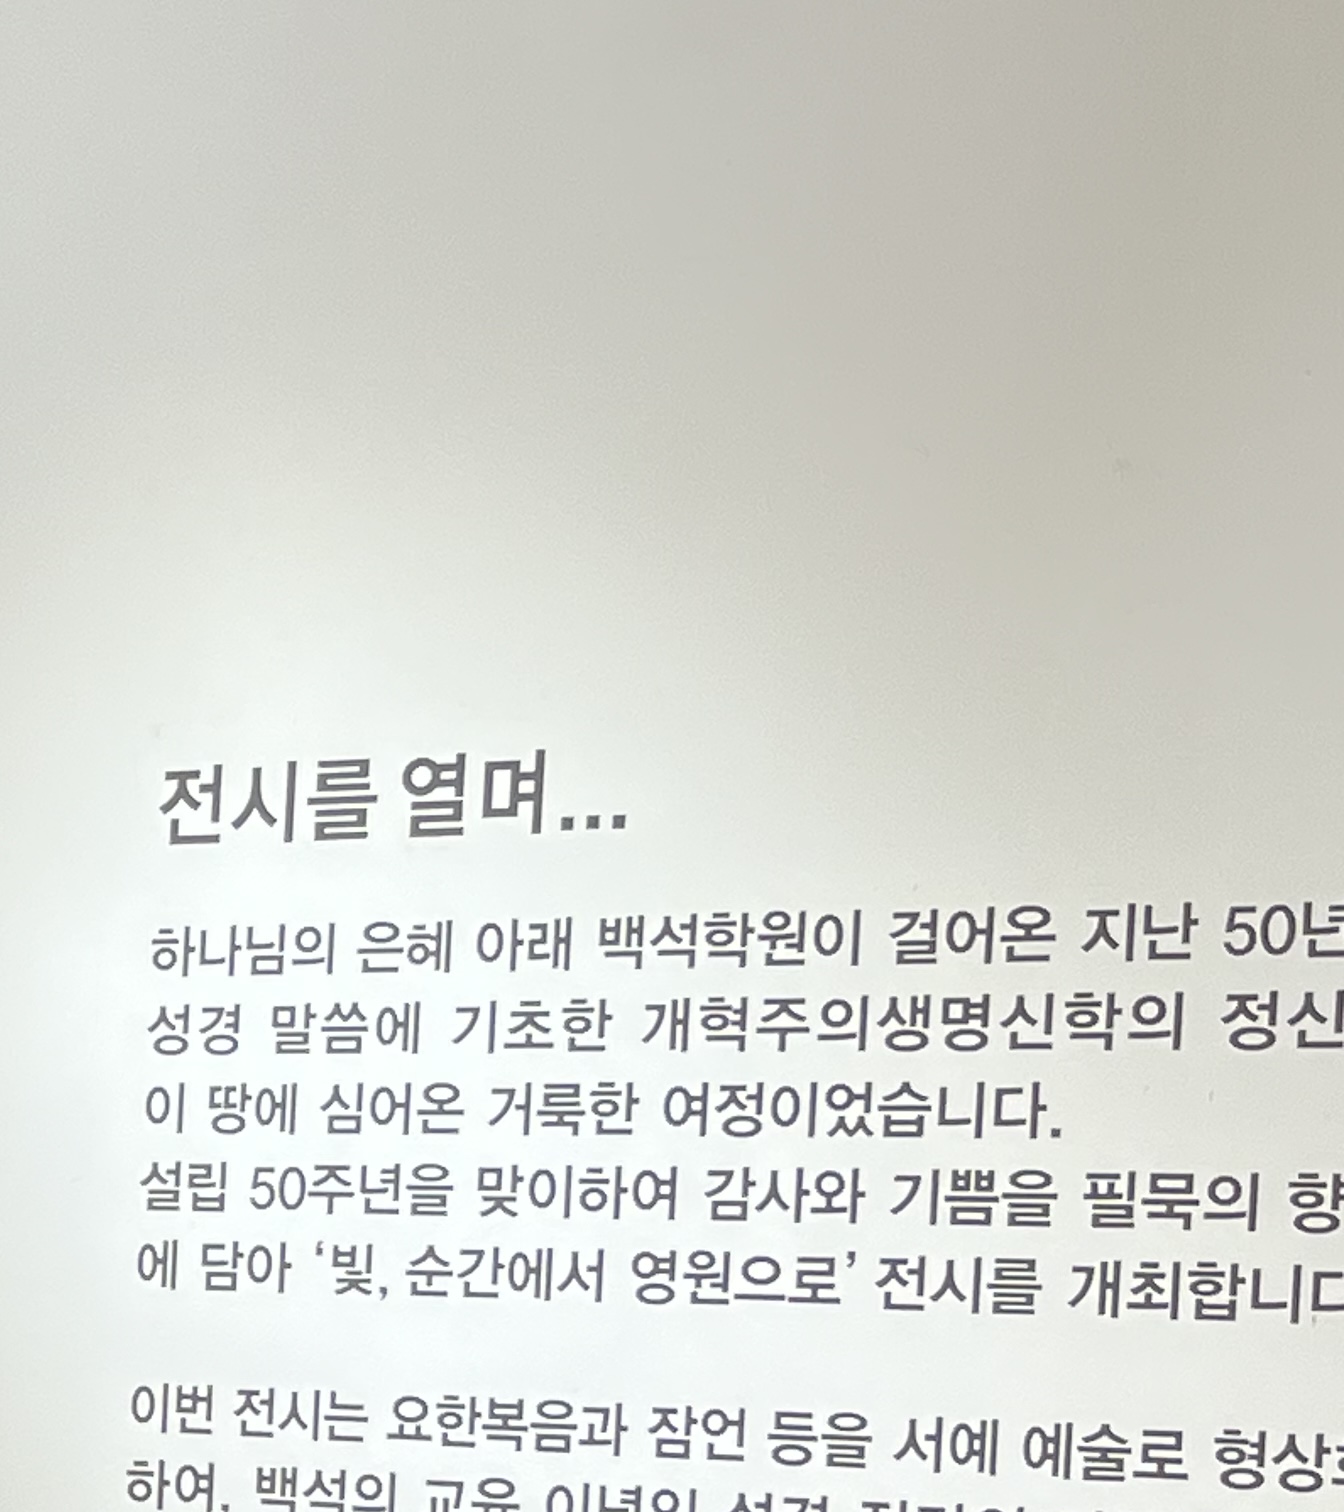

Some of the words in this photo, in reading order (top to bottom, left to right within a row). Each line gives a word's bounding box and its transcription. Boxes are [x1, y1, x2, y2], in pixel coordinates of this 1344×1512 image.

[159, 758, 379, 846] 전시를
[151, 922, 336, 978] 하나님의
[356, 919, 454, 974] 은혜
[476, 916, 573, 973] 아래
[598, 908, 862, 970] 백석학원이
[888, 905, 1057, 965] 걸어온
[1081, 901, 1200, 963] 지난
[147, 1003, 241, 1056] 성경
[271, 1000, 421, 1055] 말씀에
[452, 998, 614, 1055] 기초한
[641, 991, 1185, 1053] 개혁주의생명신학의
[1220, 989, 1344, 1052] 정신
[145, 1082, 185, 1134] 이
[208, 1082, 298, 1136] 땅에
[320, 1082, 465, 1136] 심어온
[488, 1081, 640, 1137] 거룩한
[663, 1081, 1062, 1140] 여정이었습니다.
[139, 1160, 227, 1213] 설립
[249, 1163, 454, 1217] 50주년을
[477, 1164, 678, 1221] 맞이하여
[704, 1166, 866, 1225] 감사와
[889, 1168, 1059, 1228] 기쁨을
[1083, 1170, 1260, 1233] 필묵의
[137, 1239, 179, 1291] 에
[201, 1240, 293, 1294] 담아
[405, 1244, 605, 1303] 순간에서
[874, 1255, 1043, 1315] 전시를
[131, 1382, 214, 1435] 이번
[233, 1387, 369, 1443] 전시는
[386, 1394, 629, 1457] 요한복음과
[647, 1405, 746, 1462] 잠언
[767, 1411, 873, 1469] 등을
[893, 1416, 1000, 1477] 서예
[1023, 1421, 1189, 1483] 예술로
[1213, 1428, 1344, 1493] 형상
